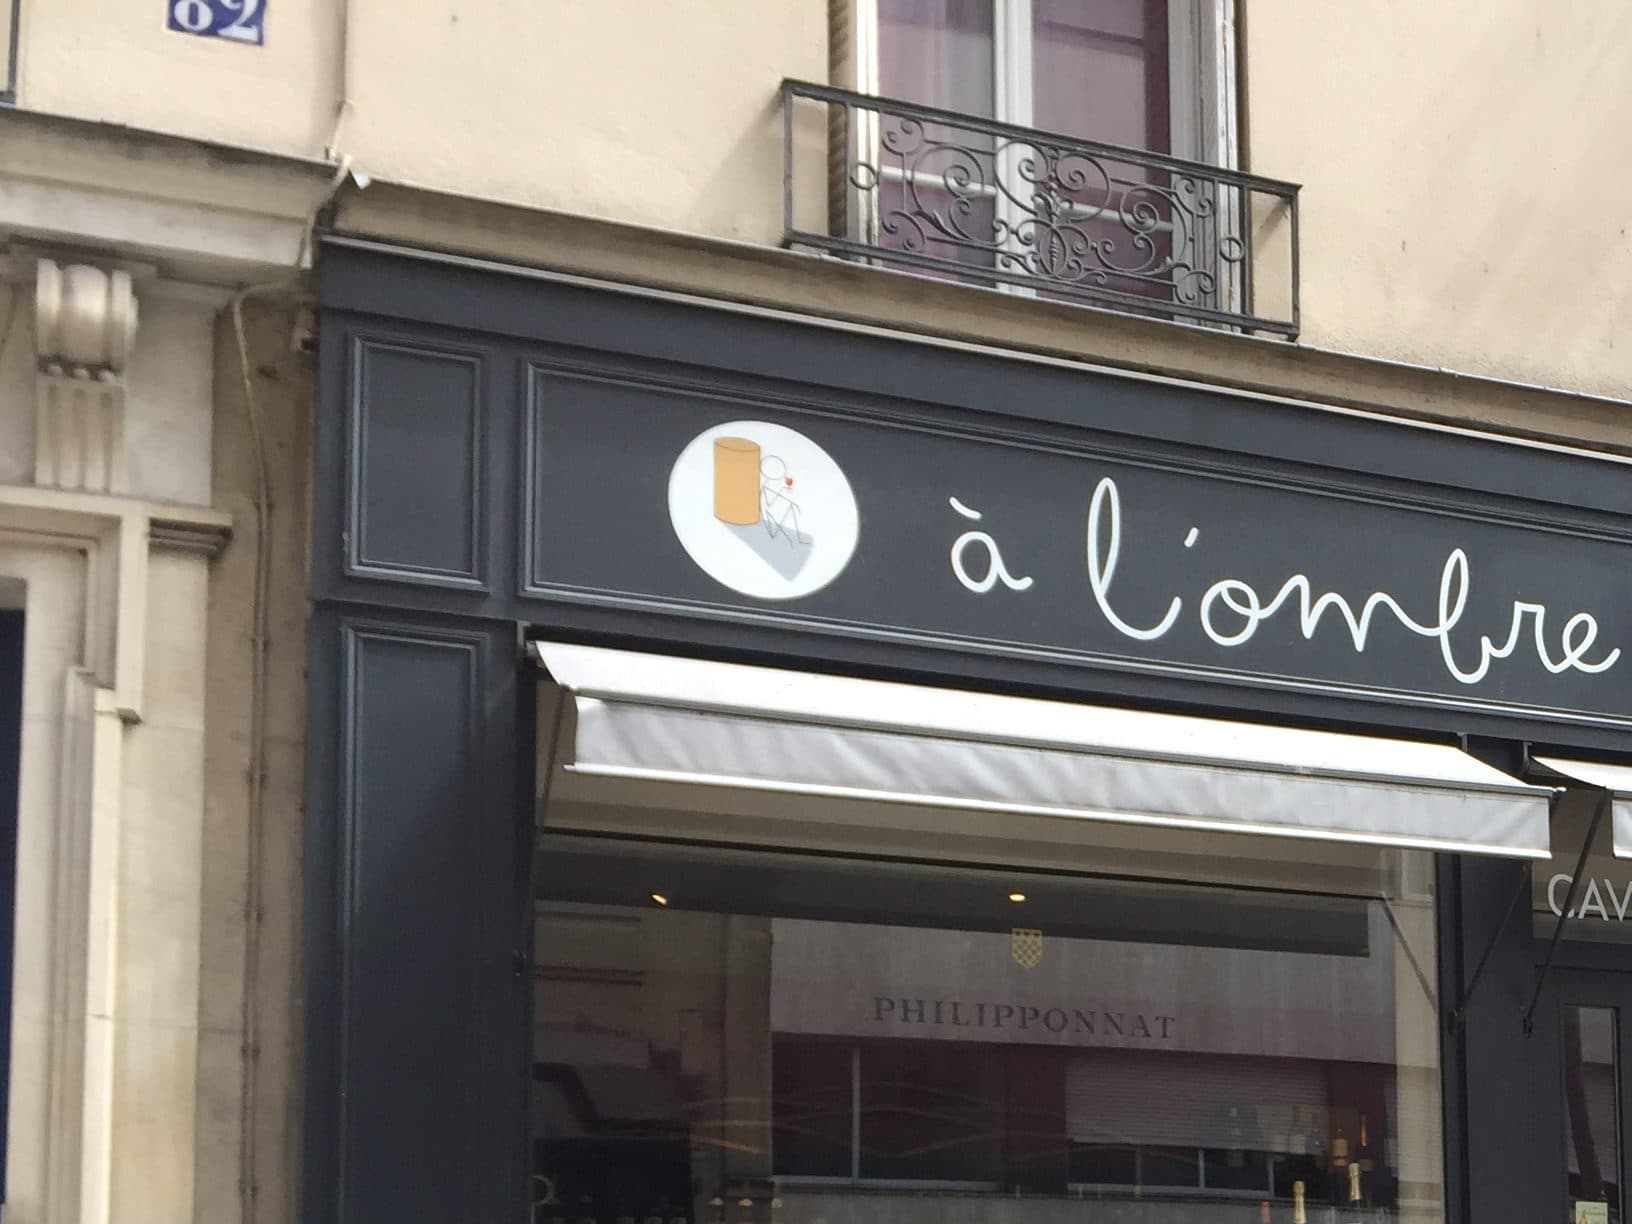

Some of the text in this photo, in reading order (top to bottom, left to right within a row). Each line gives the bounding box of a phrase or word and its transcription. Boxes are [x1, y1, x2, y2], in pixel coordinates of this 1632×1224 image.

[949, 496, 1034, 593] à
[1087, 477, 1622, 684] l'ombre
[872, 997, 1176, 1040] PHILIPPONNAT
